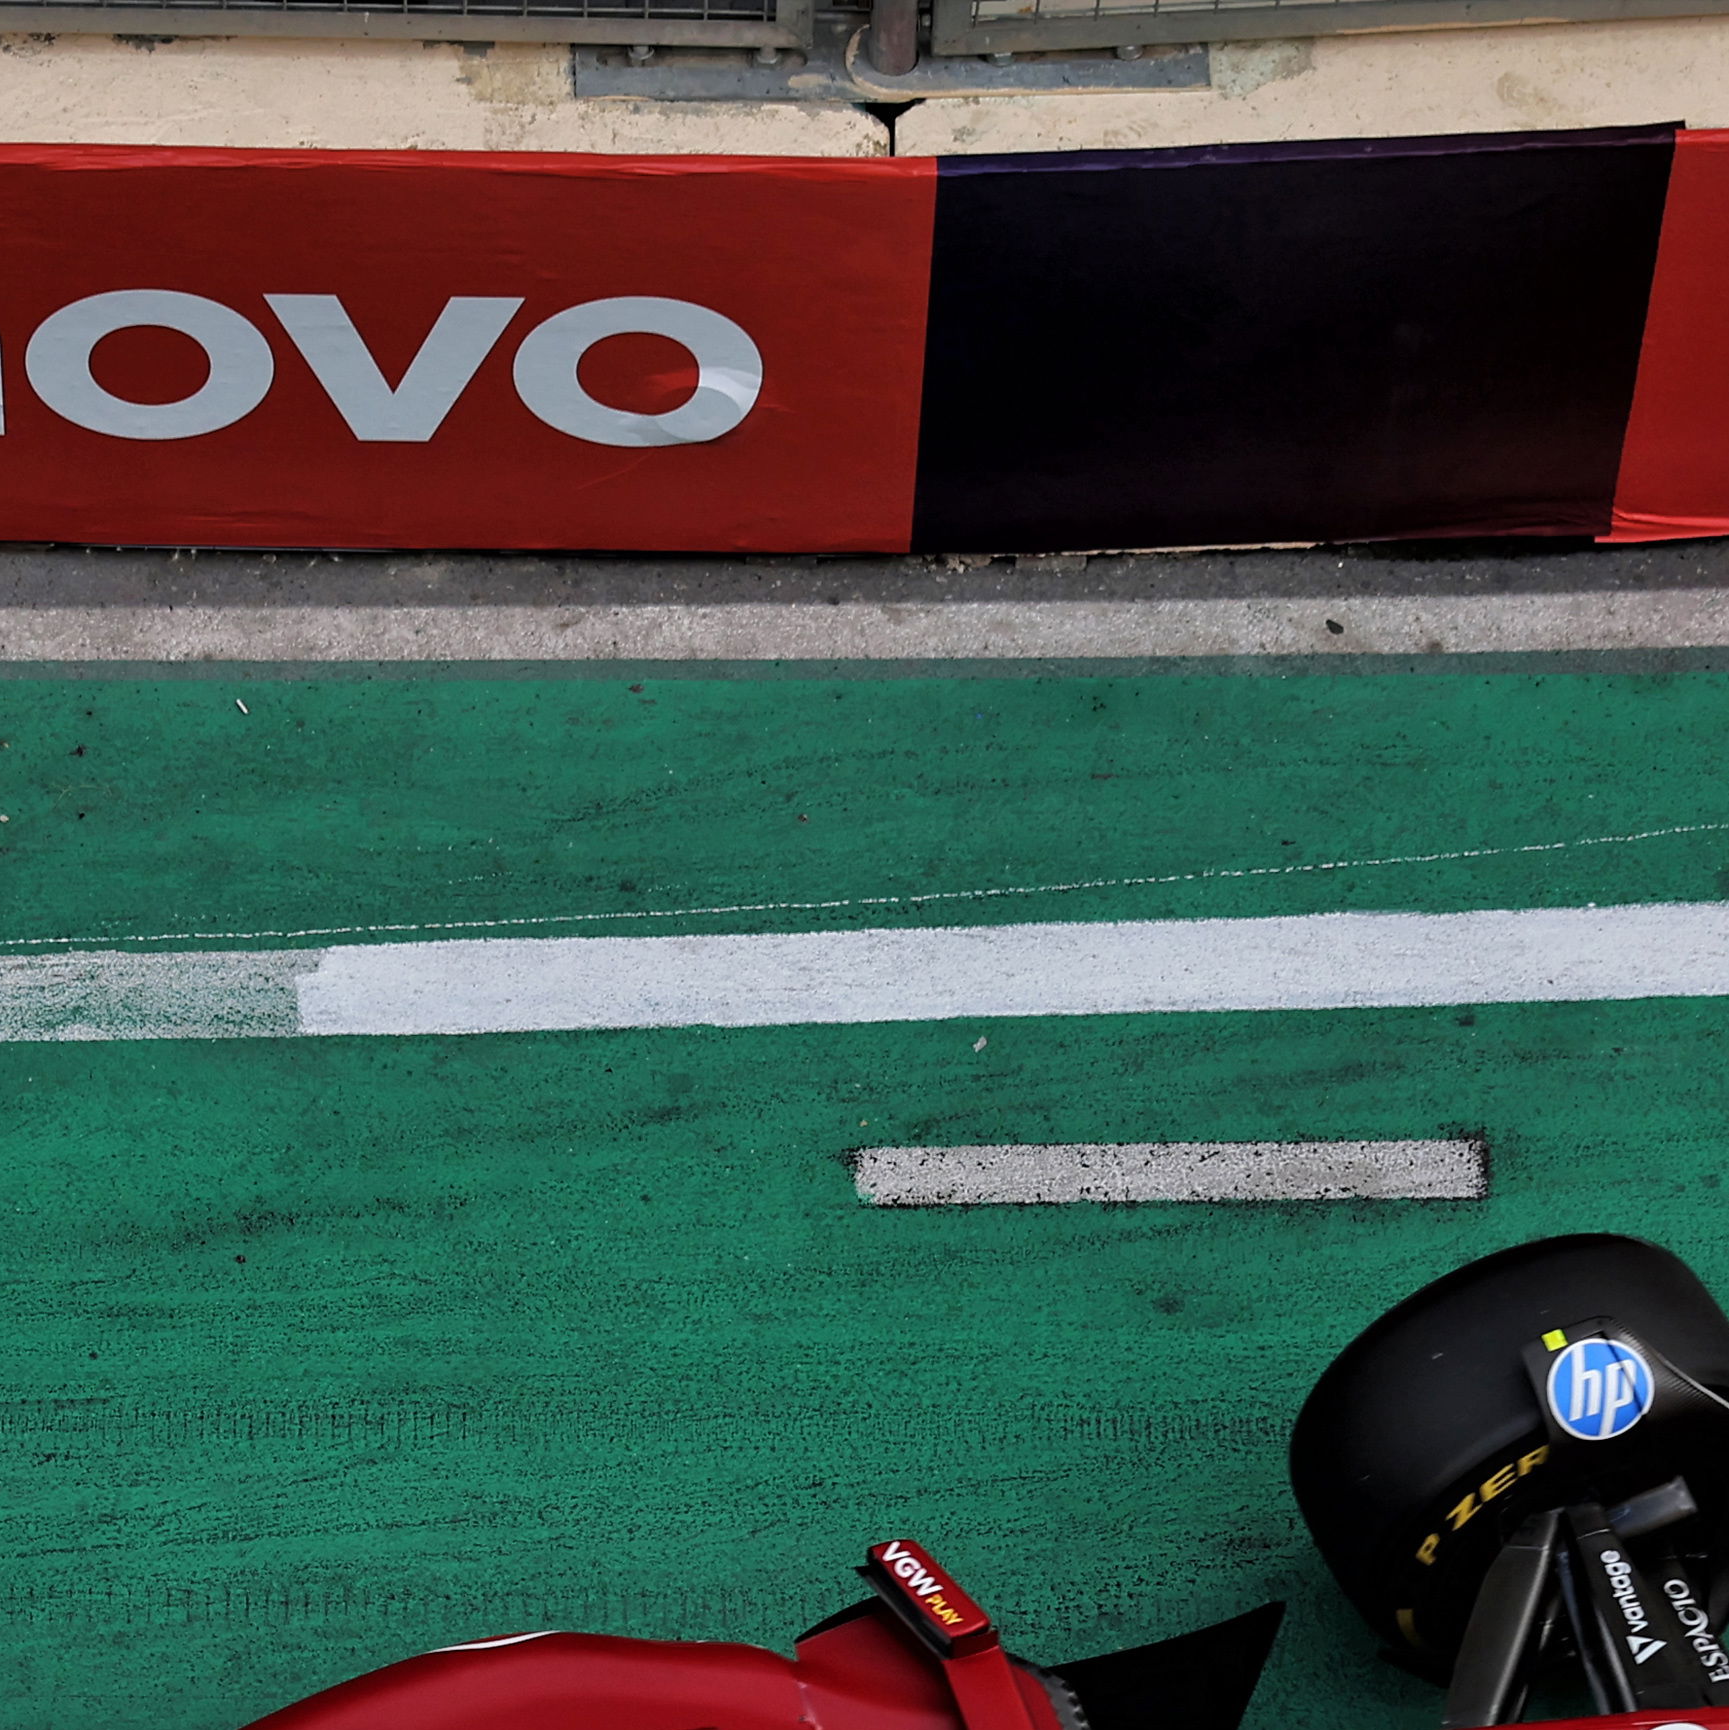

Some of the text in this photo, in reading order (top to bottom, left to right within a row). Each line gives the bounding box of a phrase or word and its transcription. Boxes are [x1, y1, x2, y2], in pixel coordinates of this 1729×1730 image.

[1564, 1338, 1640, 1438] hp
[1415, 1445, 1550, 1565] P ZER
[881, 1541, 943, 1598] VGW
[925, 1594, 963, 1626] PLAY
